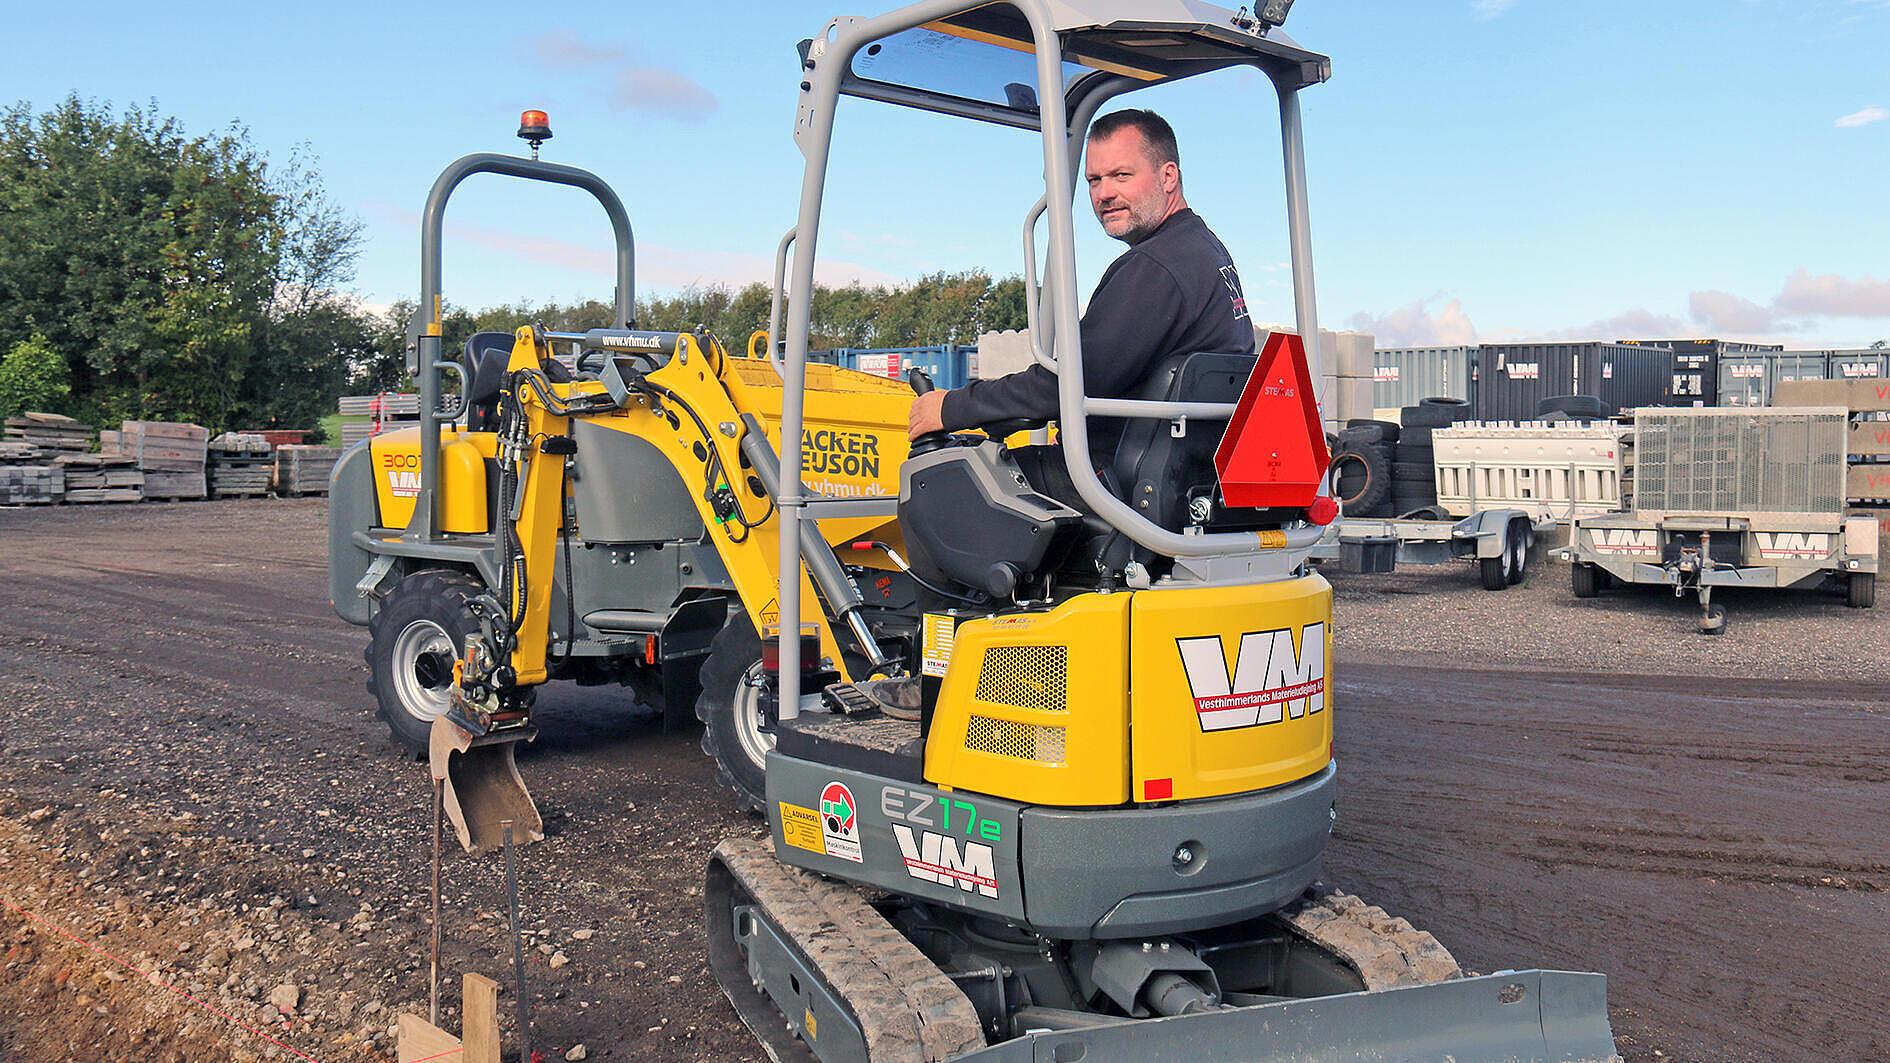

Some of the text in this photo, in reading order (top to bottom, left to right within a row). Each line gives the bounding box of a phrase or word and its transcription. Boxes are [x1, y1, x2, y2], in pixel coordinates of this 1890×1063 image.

[602, 334, 661, 349] www.vhmu.dk
[801, 429, 879, 456] ACKER
[800, 451, 880, 478] EUSON
[1590, 529, 1658, 555] VM
[1755, 532, 1829, 559] VM
[1175, 621, 1324, 733] VM
[1198, 690, 1271, 710] Vesthimmerlands
[881, 785, 1001, 841] EZ17e
[891, 822, 999, 900] VM
